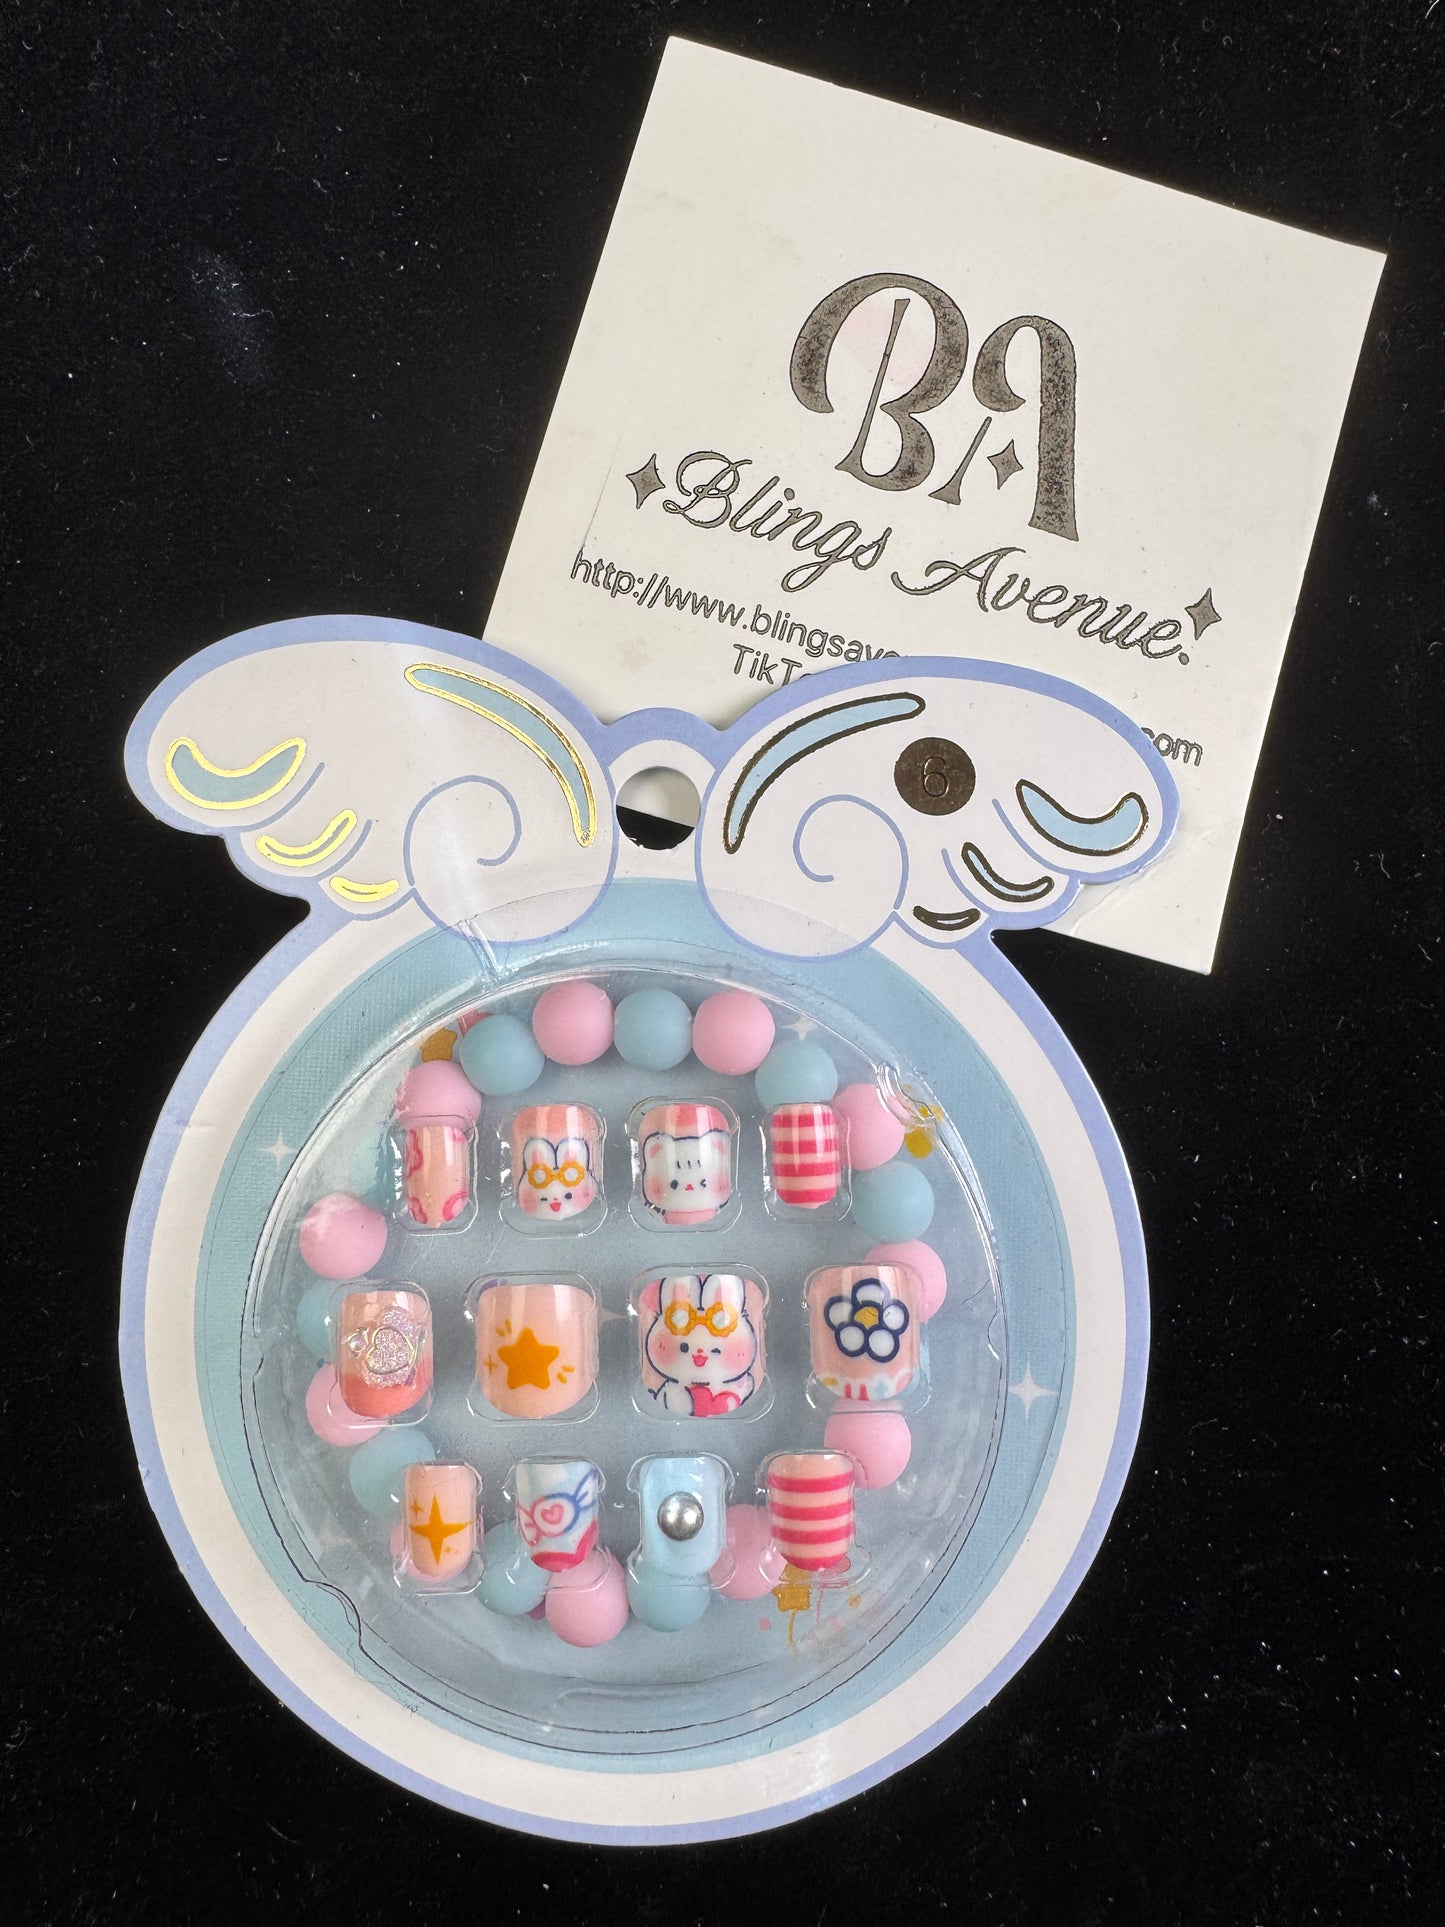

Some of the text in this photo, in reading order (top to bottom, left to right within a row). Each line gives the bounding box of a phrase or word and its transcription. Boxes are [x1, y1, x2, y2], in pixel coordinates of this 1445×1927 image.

[789, 272, 1079, 541] BA
[662, 450, 893, 593] Blings
[732, 643, 812, 687] TikT
[923, 755, 949, 797] 6
